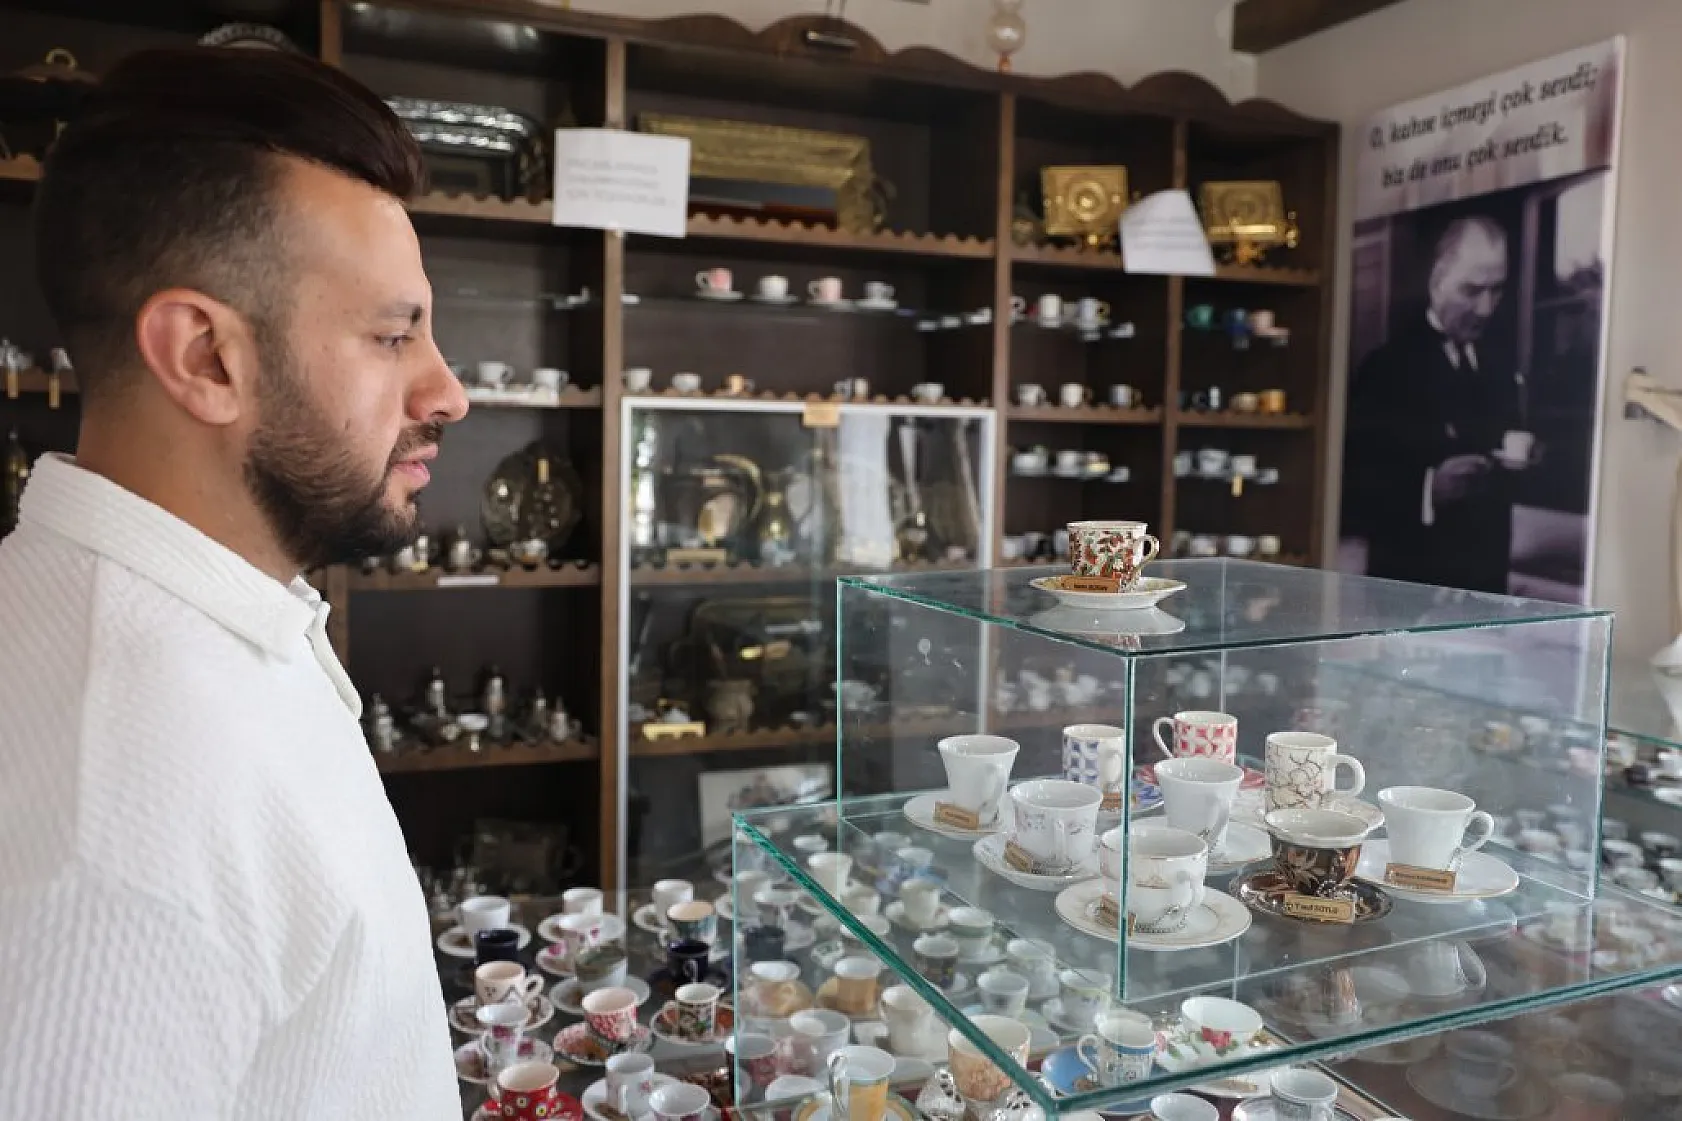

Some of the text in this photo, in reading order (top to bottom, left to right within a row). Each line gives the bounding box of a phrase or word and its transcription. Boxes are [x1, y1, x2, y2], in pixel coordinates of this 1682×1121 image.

[1390, 114, 1437, 144] kahve
[1440, 90, 1497, 129] içmeyi
[1500, 79, 1535, 117] çok
[1382, 165, 1404, 189] biz
[1408, 157, 1428, 181] de
[1430, 153, 1462, 177] onu
[1465, 138, 1499, 174] çok
